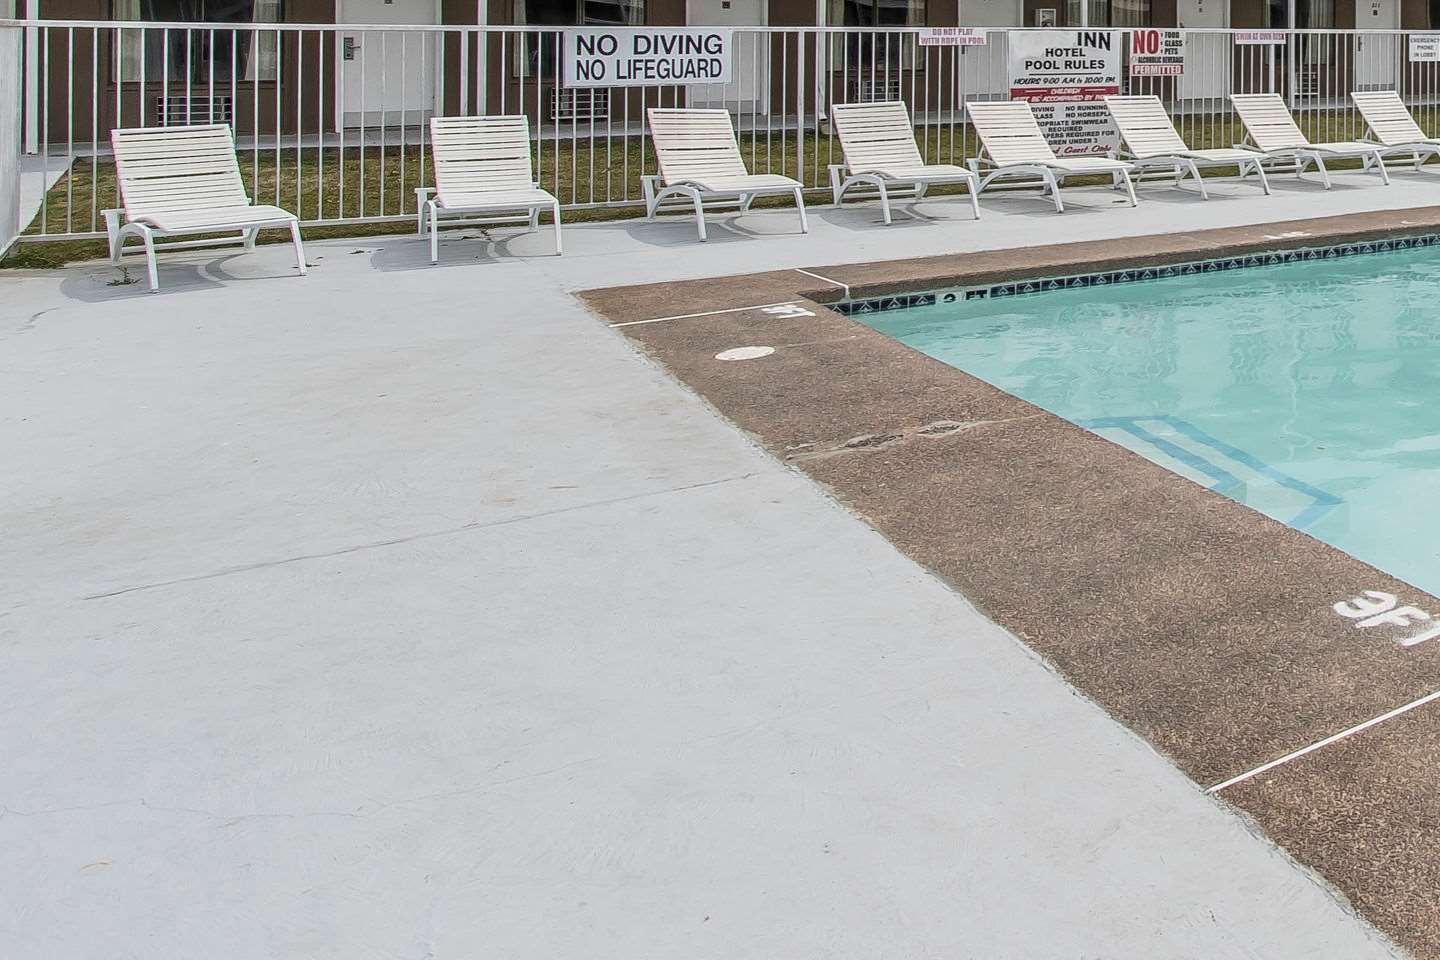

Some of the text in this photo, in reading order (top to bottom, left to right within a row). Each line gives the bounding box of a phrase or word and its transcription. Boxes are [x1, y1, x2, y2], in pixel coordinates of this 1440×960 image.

[577, 34, 722, 55] NO DIVING
[1077, 32, 1111, 51] INN
[1133, 30, 1159, 54] NO
[1045, 48, 1086, 57] HOTEL
[577, 58, 722, 80] NO LIFEGUARD
[1025, 60, 1105, 70] POOL RULES
[1134, 66, 1181, 74] PERMITTED
